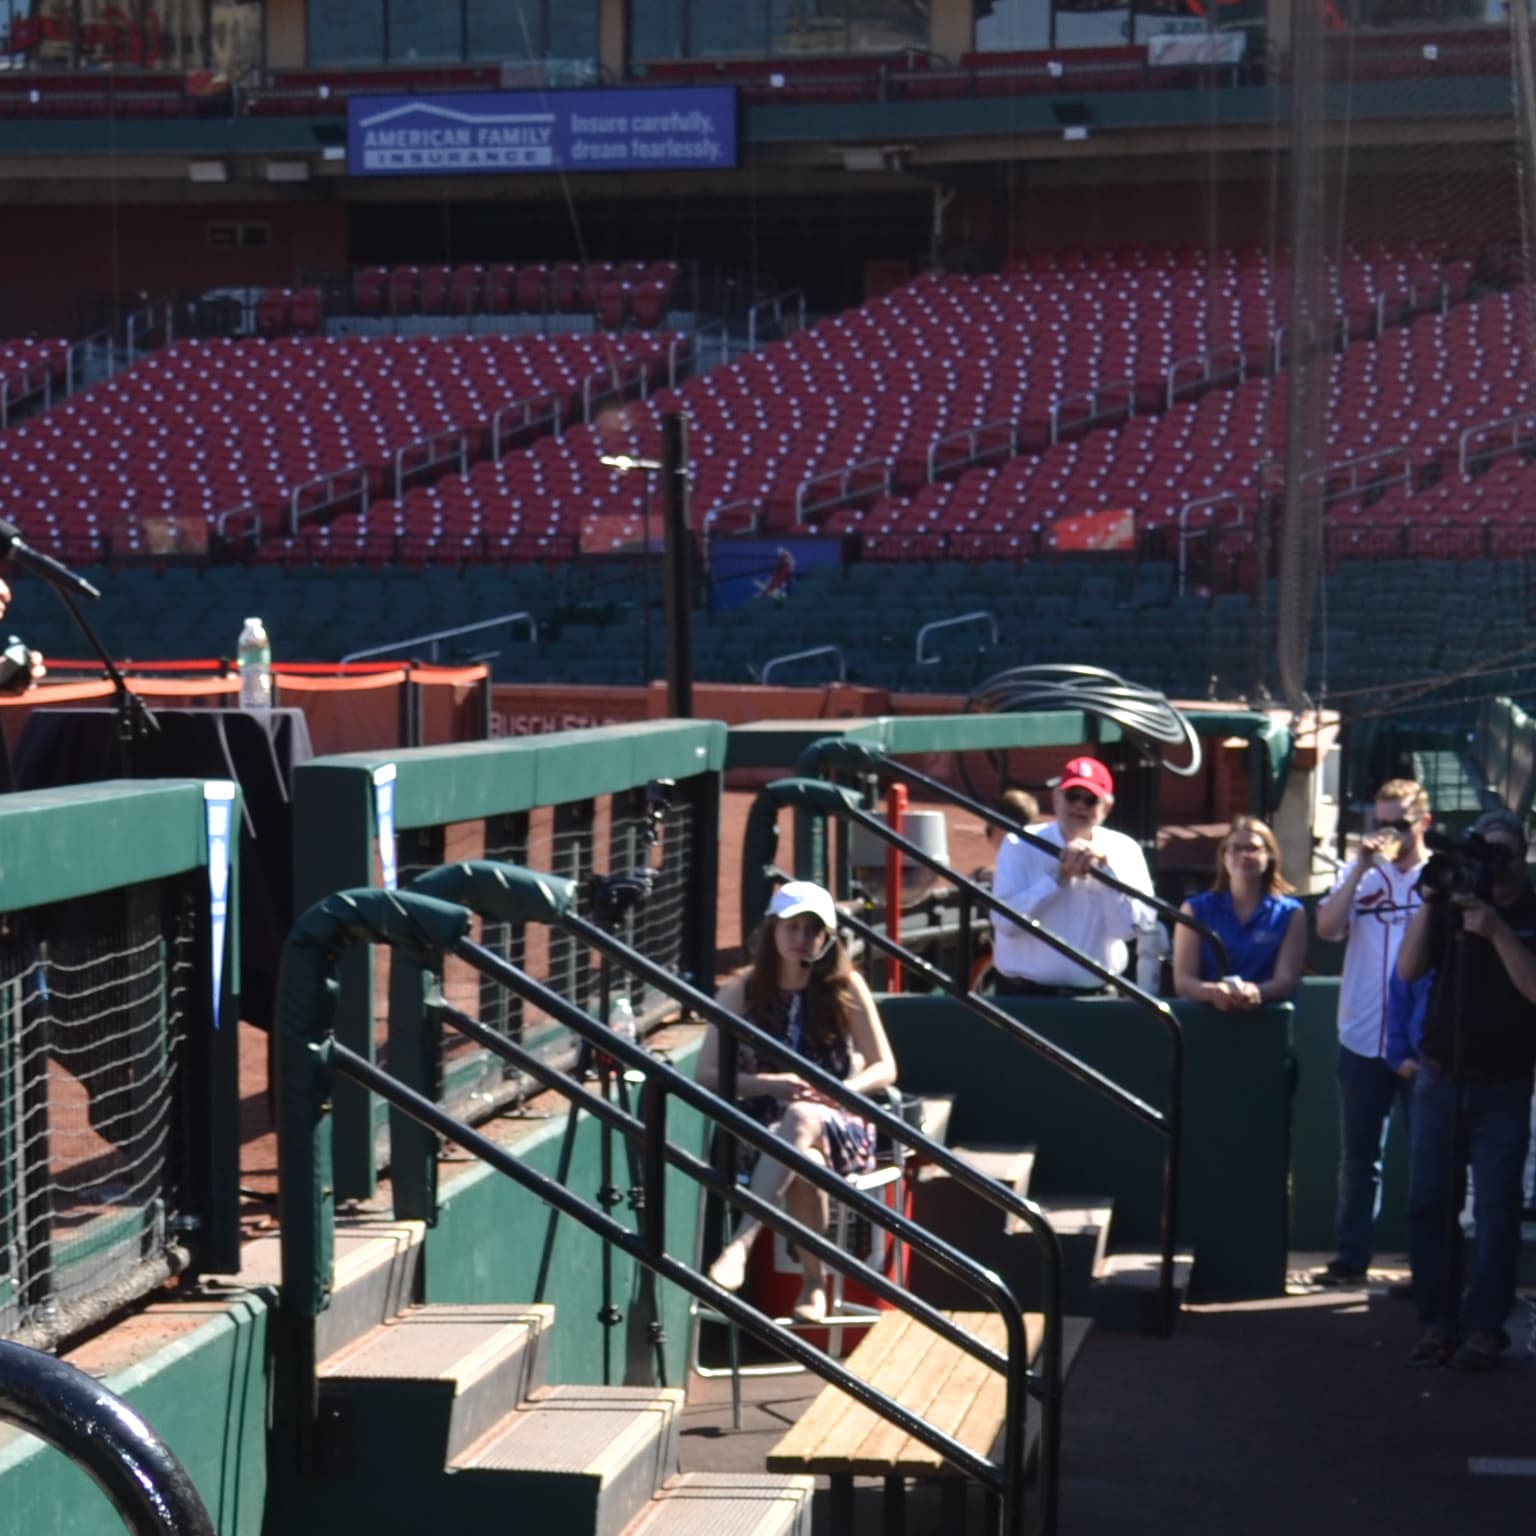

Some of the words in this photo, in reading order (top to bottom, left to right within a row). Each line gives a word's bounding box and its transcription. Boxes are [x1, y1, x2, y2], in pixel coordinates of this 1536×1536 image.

[570, 112, 627, 134] Insure
[364, 128, 471, 147] AMERICAN
[478, 126, 553, 147] FAMILY
[378, 149, 538, 165] INSURANCE
[570, 139, 628, 161] dream
